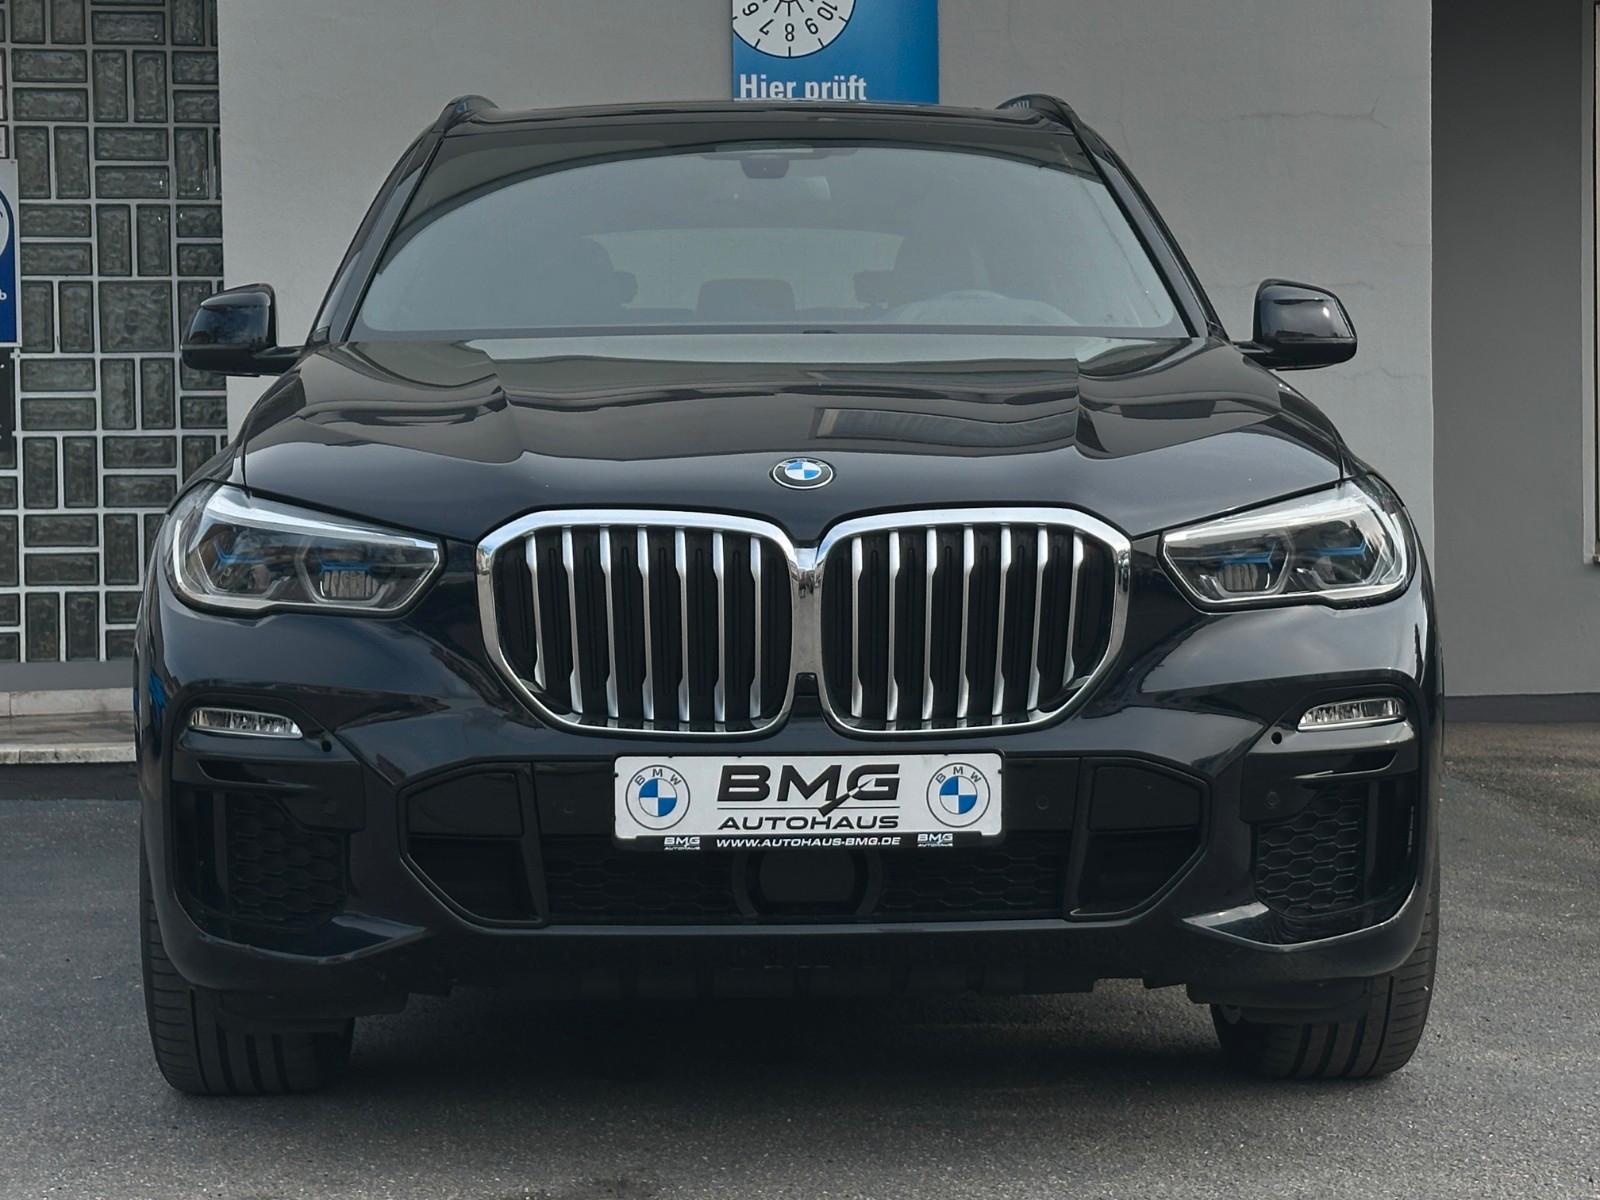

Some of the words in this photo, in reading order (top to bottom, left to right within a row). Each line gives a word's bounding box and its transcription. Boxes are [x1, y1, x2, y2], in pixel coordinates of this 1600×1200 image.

[817, 0, 838, 21] 10
[759, 18, 774, 36] 7
[784, 23, 795, 42] 8
[740, 74, 796, 99] Hier
[805, 75, 867, 100] prüft
[634, 768, 681, 786] BMW
[717, 764, 900, 802] BMG
[935, 766, 981, 784] BMW
[718, 816, 899, 830] AUTOHAUS
[664, 836, 700, 845] BMG
[716, 837, 901, 848] WWW.AUTOHAUS-BMG.DE
[917, 833, 953, 842] BMG
